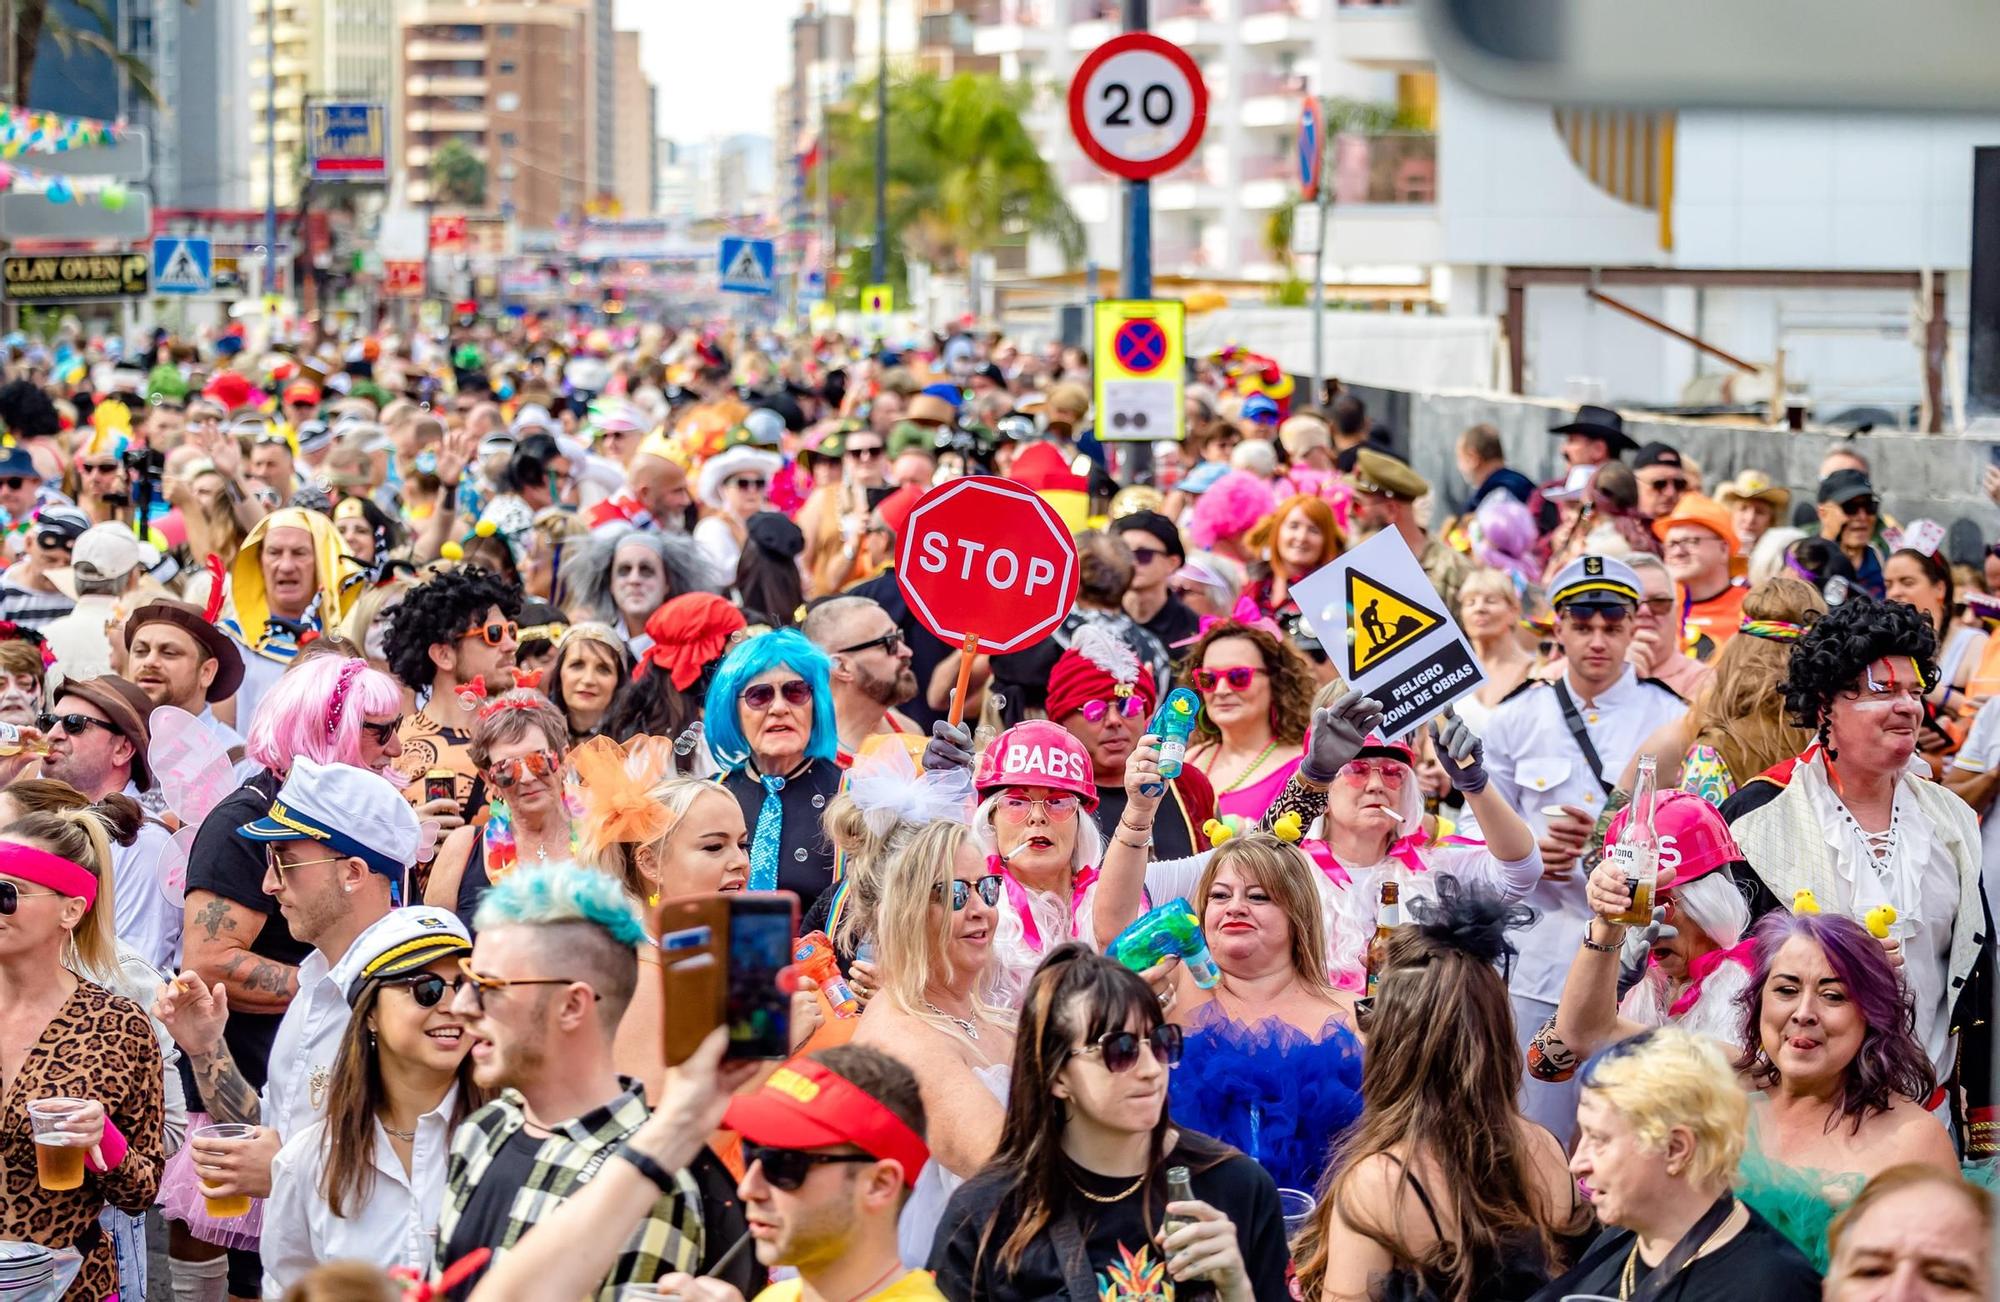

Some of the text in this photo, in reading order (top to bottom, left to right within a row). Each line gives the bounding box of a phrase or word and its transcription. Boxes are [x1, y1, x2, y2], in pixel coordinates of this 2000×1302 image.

[1103, 83, 1173, 126] 20
[919, 531, 1055, 596] STOP
[1382, 663, 1474, 728] ZONA DE OBRAS
[1392, 663, 1444, 701] PELIGRO
[1005, 744, 1084, 781] BABS
